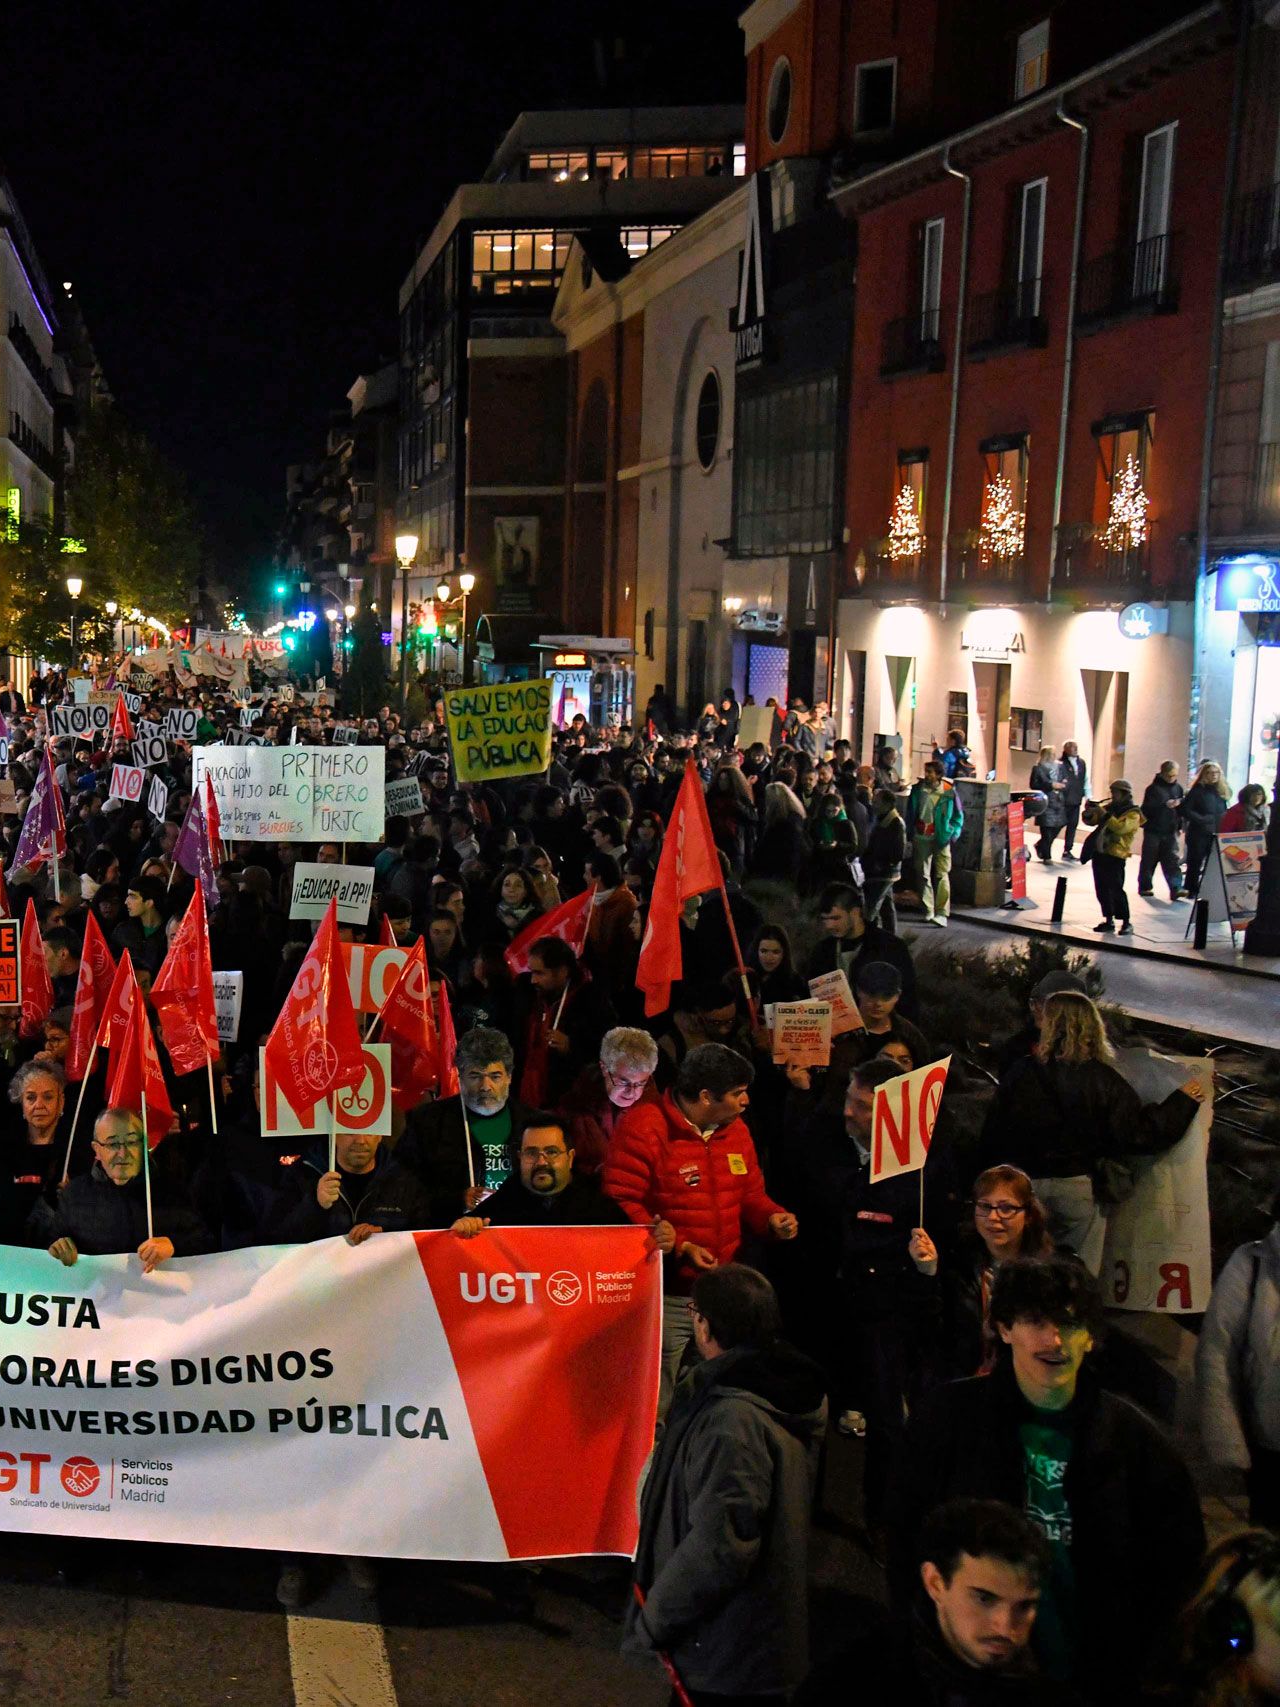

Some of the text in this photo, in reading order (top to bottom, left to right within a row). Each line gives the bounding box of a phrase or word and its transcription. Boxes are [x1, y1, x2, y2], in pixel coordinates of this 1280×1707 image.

[125, 694, 140, 712] NO
[449, 686, 551, 717] SALVEMOS
[54, 709, 87, 736] NO
[169, 709, 197, 734] NO
[458, 720, 477, 741] LA
[133, 737, 165, 768] NO
[468, 739, 543, 770] PÚBLICA
[281, 753, 369, 779] PRIMERO
[111, 767, 142, 799] NO
[214, 784, 369, 805] AL HIJO DEL OBRERO
[149, 776, 166, 818] NO
[269, 811, 281, 820] AL
[235, 825, 251, 834] DEL
[340, 881, 352, 901] al
[349, 882, 372, 904] PP!!
[873, 1066, 948, 1175] NO
[595, 1271, 636, 1281] Servicios
[596, 1282, 633, 1292] Públicos
[459, 1272, 541, 1304] UGT
[597, 1292, 631, 1304] Madrid
[171, 1347, 335, 1387] DIGNOS
[269, 1396, 450, 1442] PÚBLICA
[121, 1458, 173, 1471] Servicios
[121, 1473, 169, 1486] Públicos
[10, 1497, 111, 1512] Sindicato de Universidad
[121, 1488, 165, 1503] Madrid
